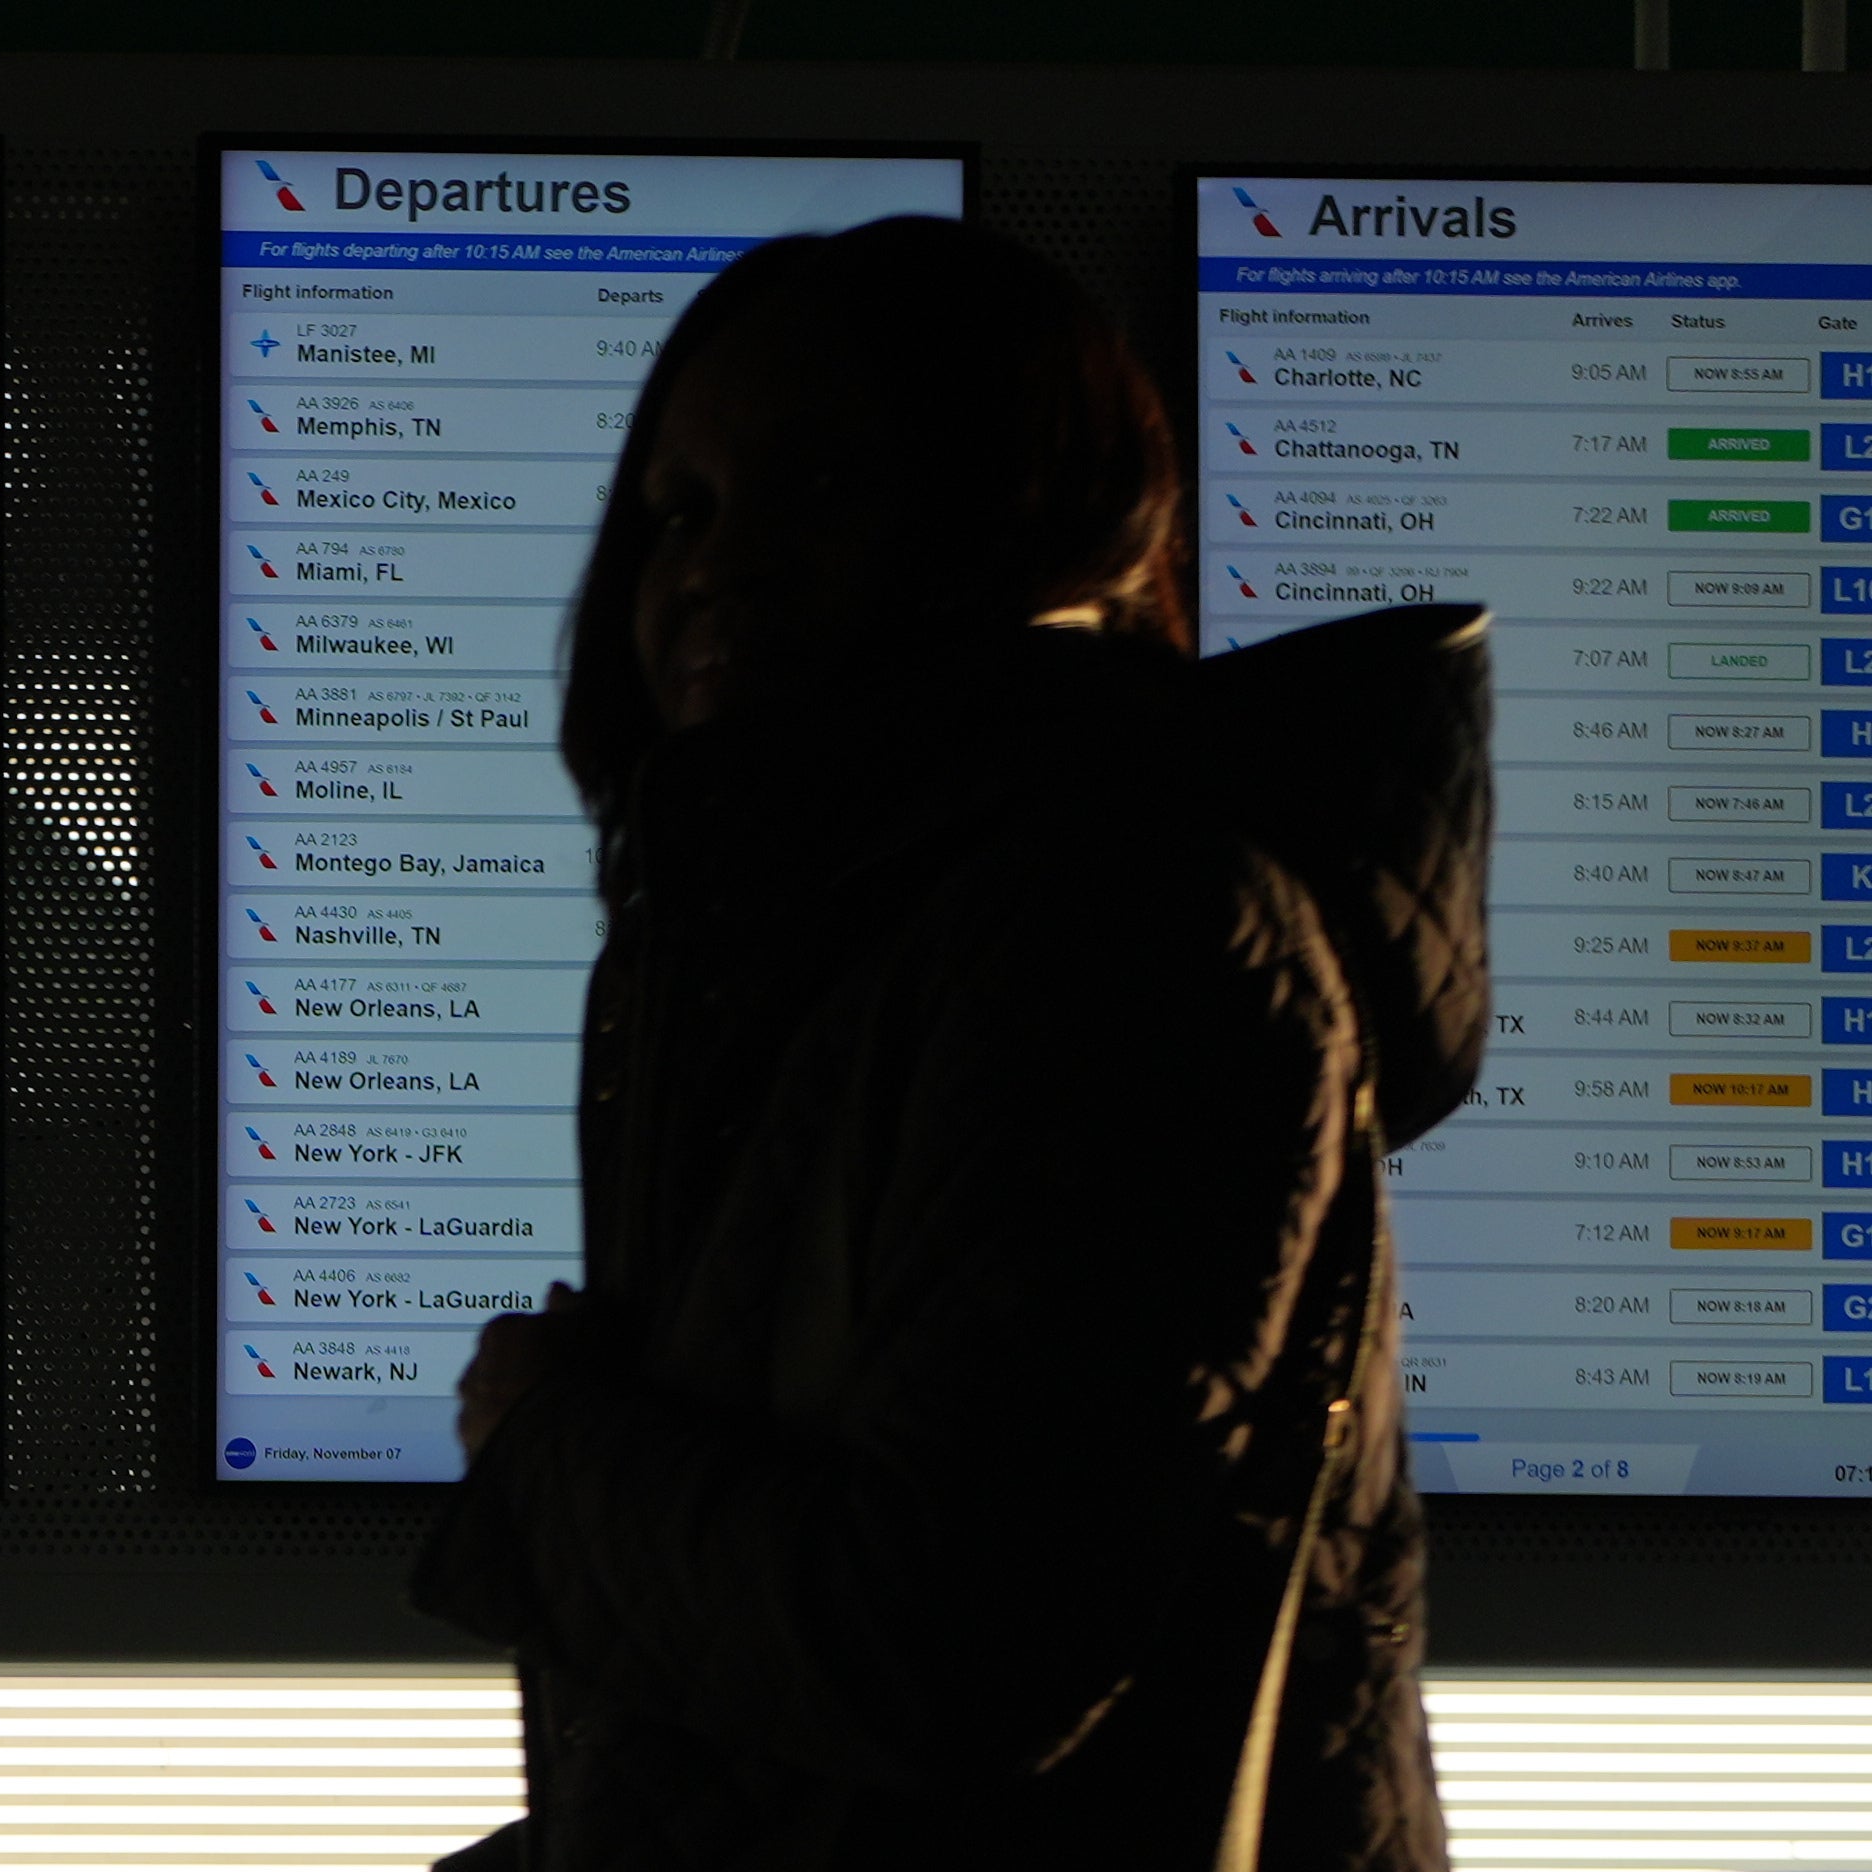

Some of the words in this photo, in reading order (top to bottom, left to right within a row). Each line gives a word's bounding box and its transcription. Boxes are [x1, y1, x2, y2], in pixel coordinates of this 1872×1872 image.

[336, 167, 631, 223] Departures
[1308, 194, 1517, 239] Arrivals
[297, 323, 317, 337] LF
[320, 323, 358, 338] 3027
[1818, 315, 1858, 330] Gate
[297, 343, 403, 367] Manistee,
[410, 345, 435, 364] MI
[1274, 367, 1382, 389] Charlotte,
[1389, 368, 1422, 388] NC
[1274, 439, 1422, 464] Chattanooga,
[1429, 440, 1459, 460] TN
[1707, 437, 1771, 451] ARRIVED
[297, 489, 376, 509] Mexico
[382, 490, 430, 514] City,
[438, 490, 517, 511] Mexico
[1711, 655, 1769, 668] LANDED
[296, 780, 375, 803] Moline,
[383, 781, 403, 800] IL
[1574, 1079, 1615, 1098] 9:58
[1618, 1080, 1649, 1098] AM
[294, 1361, 382, 1385] Newark,
[390, 1362, 418, 1381] NJ
[1512, 1458, 1565, 1483] Page
[1571, 1459, 1585, 1479] 2
[1590, 1459, 1611, 1479] of
[1616, 1459, 1629, 1479] 8
